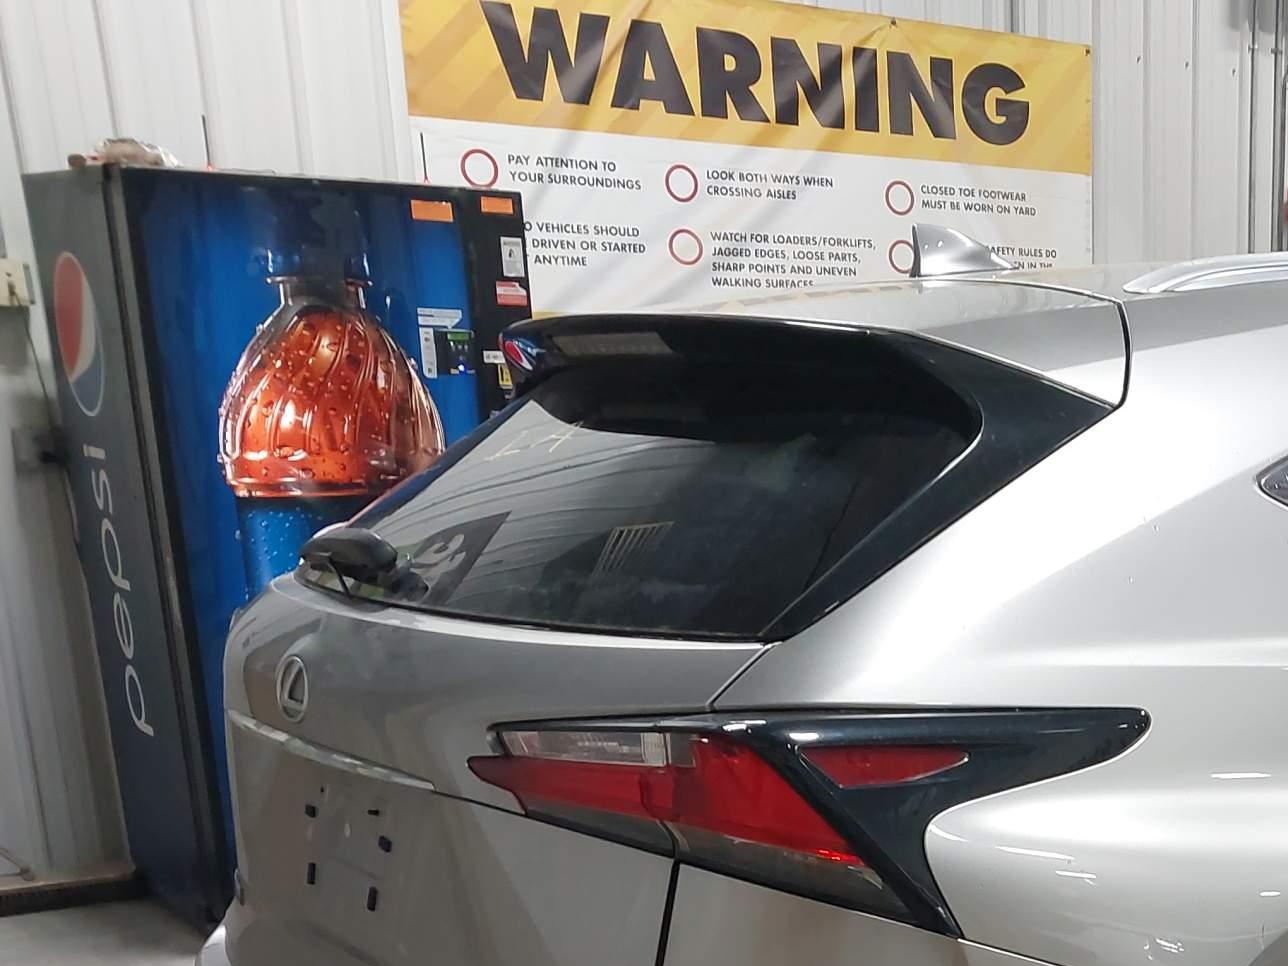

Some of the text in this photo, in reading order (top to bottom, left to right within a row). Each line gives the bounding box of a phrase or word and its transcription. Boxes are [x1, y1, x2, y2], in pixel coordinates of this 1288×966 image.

[478, 0, 1030, 145] WARNING
[508, 154, 616, 172] PAY ATTENTION TO
[510, 171, 641, 190] YOUR SURROUNDINGS
[706, 170, 833, 188] LOOK BOTH WAYS WHEN
[706, 185, 797, 200] CROSSING AISLES
[921, 185, 1026, 201] CLOSED TOE FOOTWEAR
[921, 199, 1036, 216] MUST BE WORN ON YARD
[536, 222, 589, 235] VEHICLES
[593, 225, 640, 237] SHOULD
[532, 238, 576, 250] DRIVEN
[580, 240, 597, 251] OR
[601, 242, 646, 253] STARTED
[710, 231, 876, 250] WATCH FOR LOADERS/FORKLIFTS,
[534, 254, 588, 267] ANYTIME
[711, 247, 861, 264] JAGGED EDGES, LOOSE PARTS,
[1018, 248, 1043, 257] RULES
[1045, 249, 1057, 258] DO
[712, 262, 857, 277] SHARP POINTS AND UNEVEN
[711, 277, 762, 288] WALKING
[83, 444, 154, 737] pepsi
